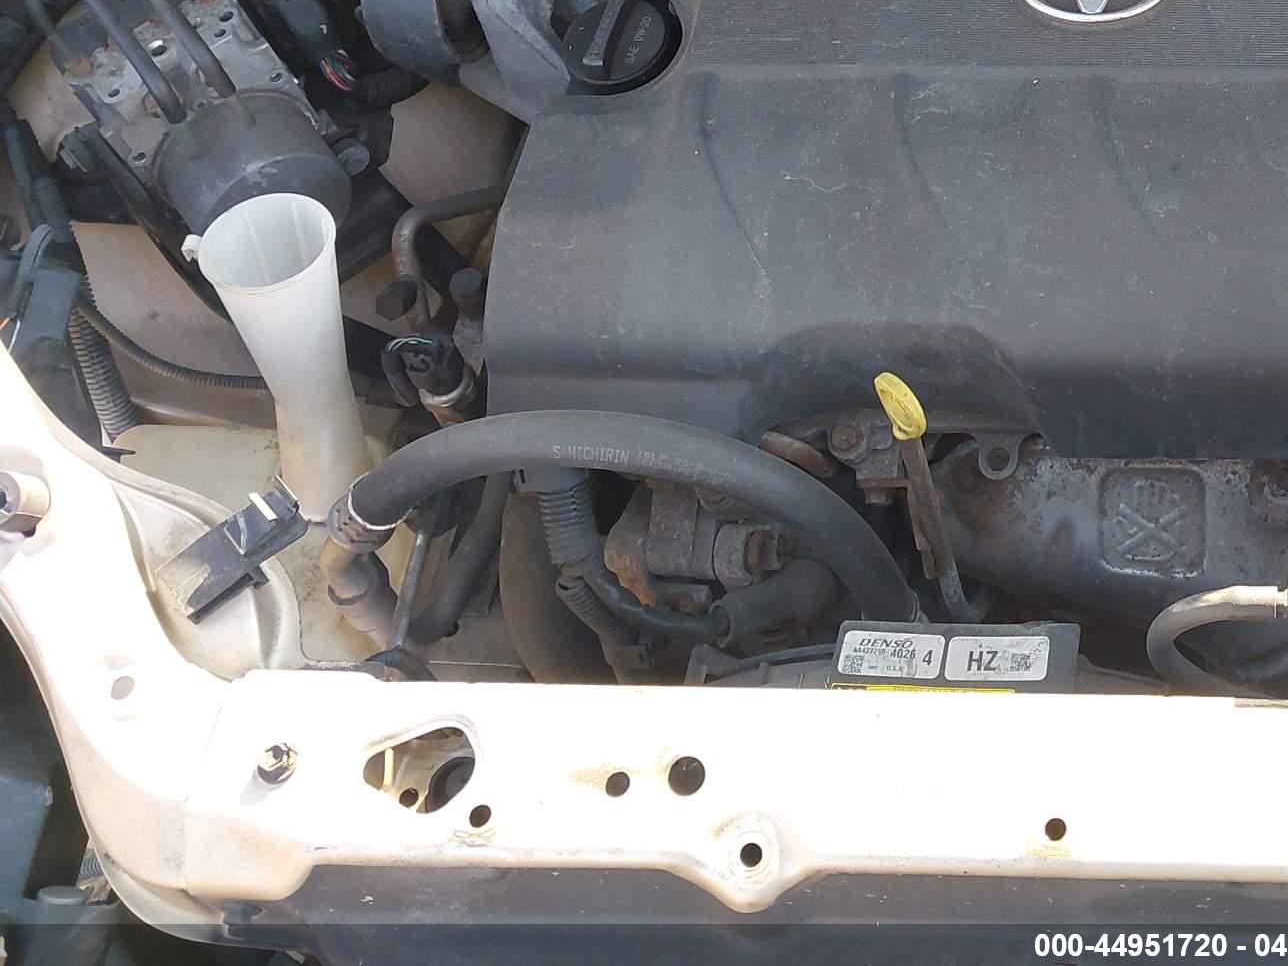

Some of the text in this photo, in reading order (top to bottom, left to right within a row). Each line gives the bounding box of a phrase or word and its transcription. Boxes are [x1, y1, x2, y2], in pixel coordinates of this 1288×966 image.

[625, 45, 640, 64] SAE
[859, 637, 914, 649] DENSO
[922, 649, 934, 666] 4
[966, 650, 998, 672] HZ
